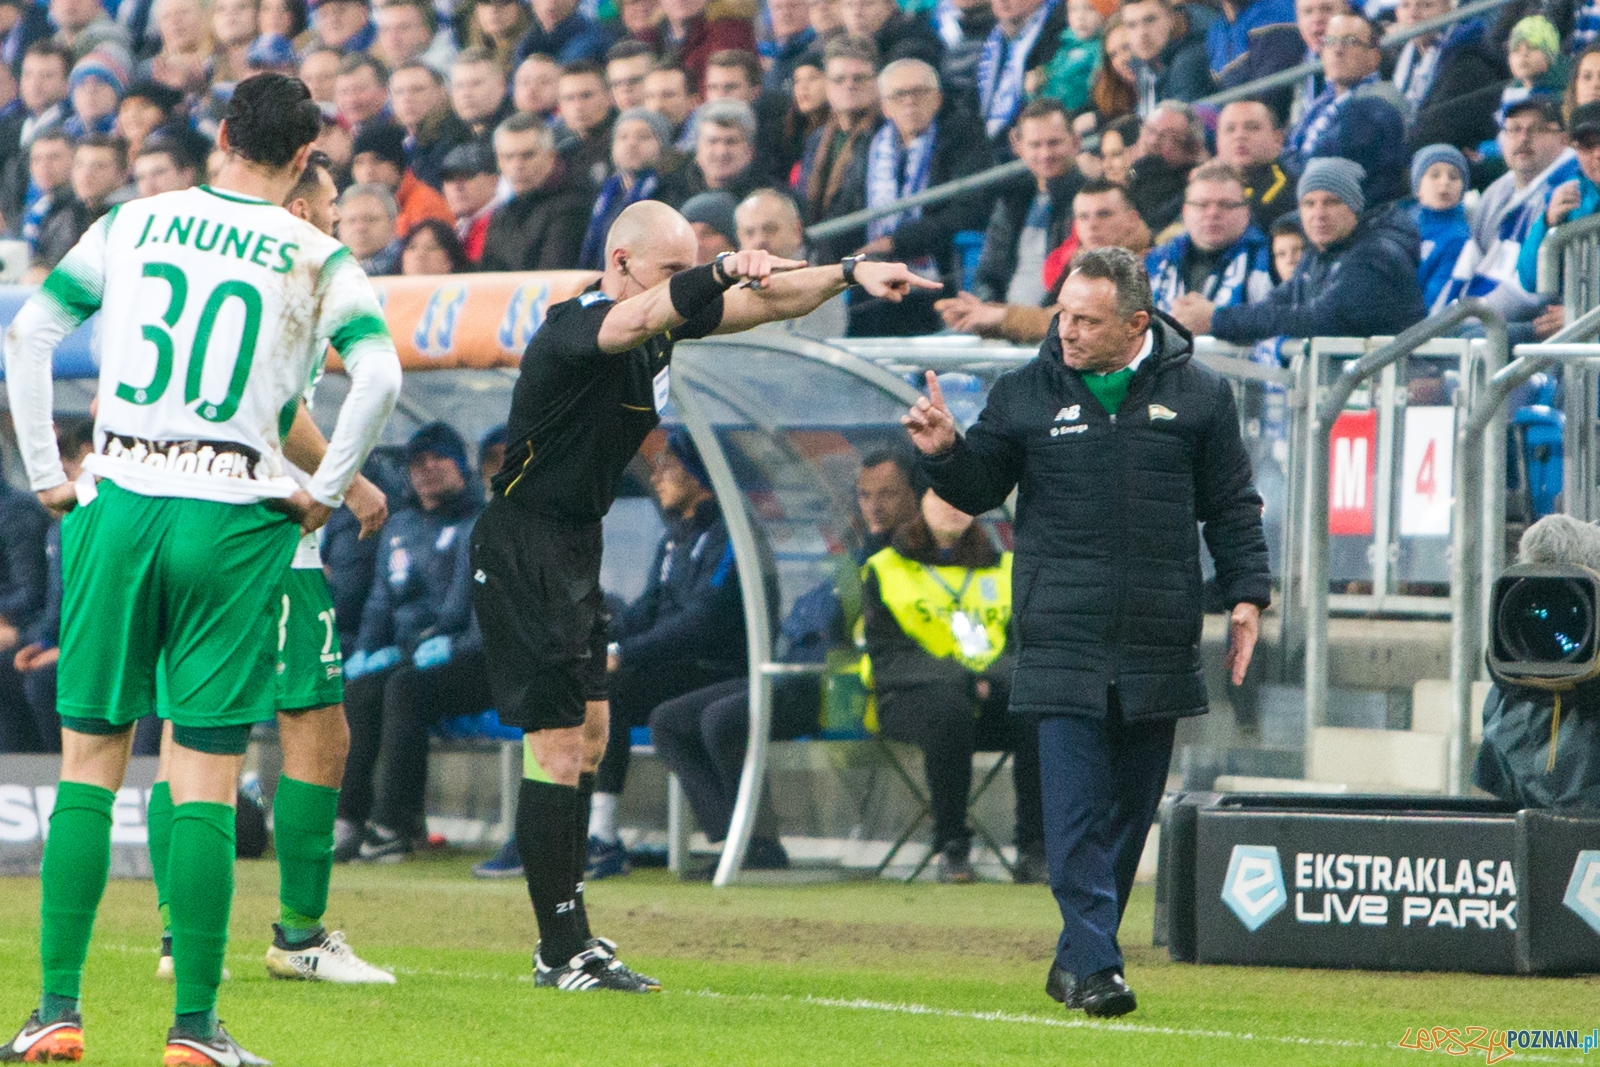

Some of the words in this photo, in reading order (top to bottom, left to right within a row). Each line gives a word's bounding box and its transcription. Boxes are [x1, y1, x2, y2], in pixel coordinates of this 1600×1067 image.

[134, 214, 299, 274] J.NUNES
[115, 261, 263, 423] 30
[1333, 437, 1368, 509] M
[1415, 438, 1436, 505] 4
[1296, 852, 1517, 897] EKSTRAKLASA
[1403, 896, 1517, 930] PARK
